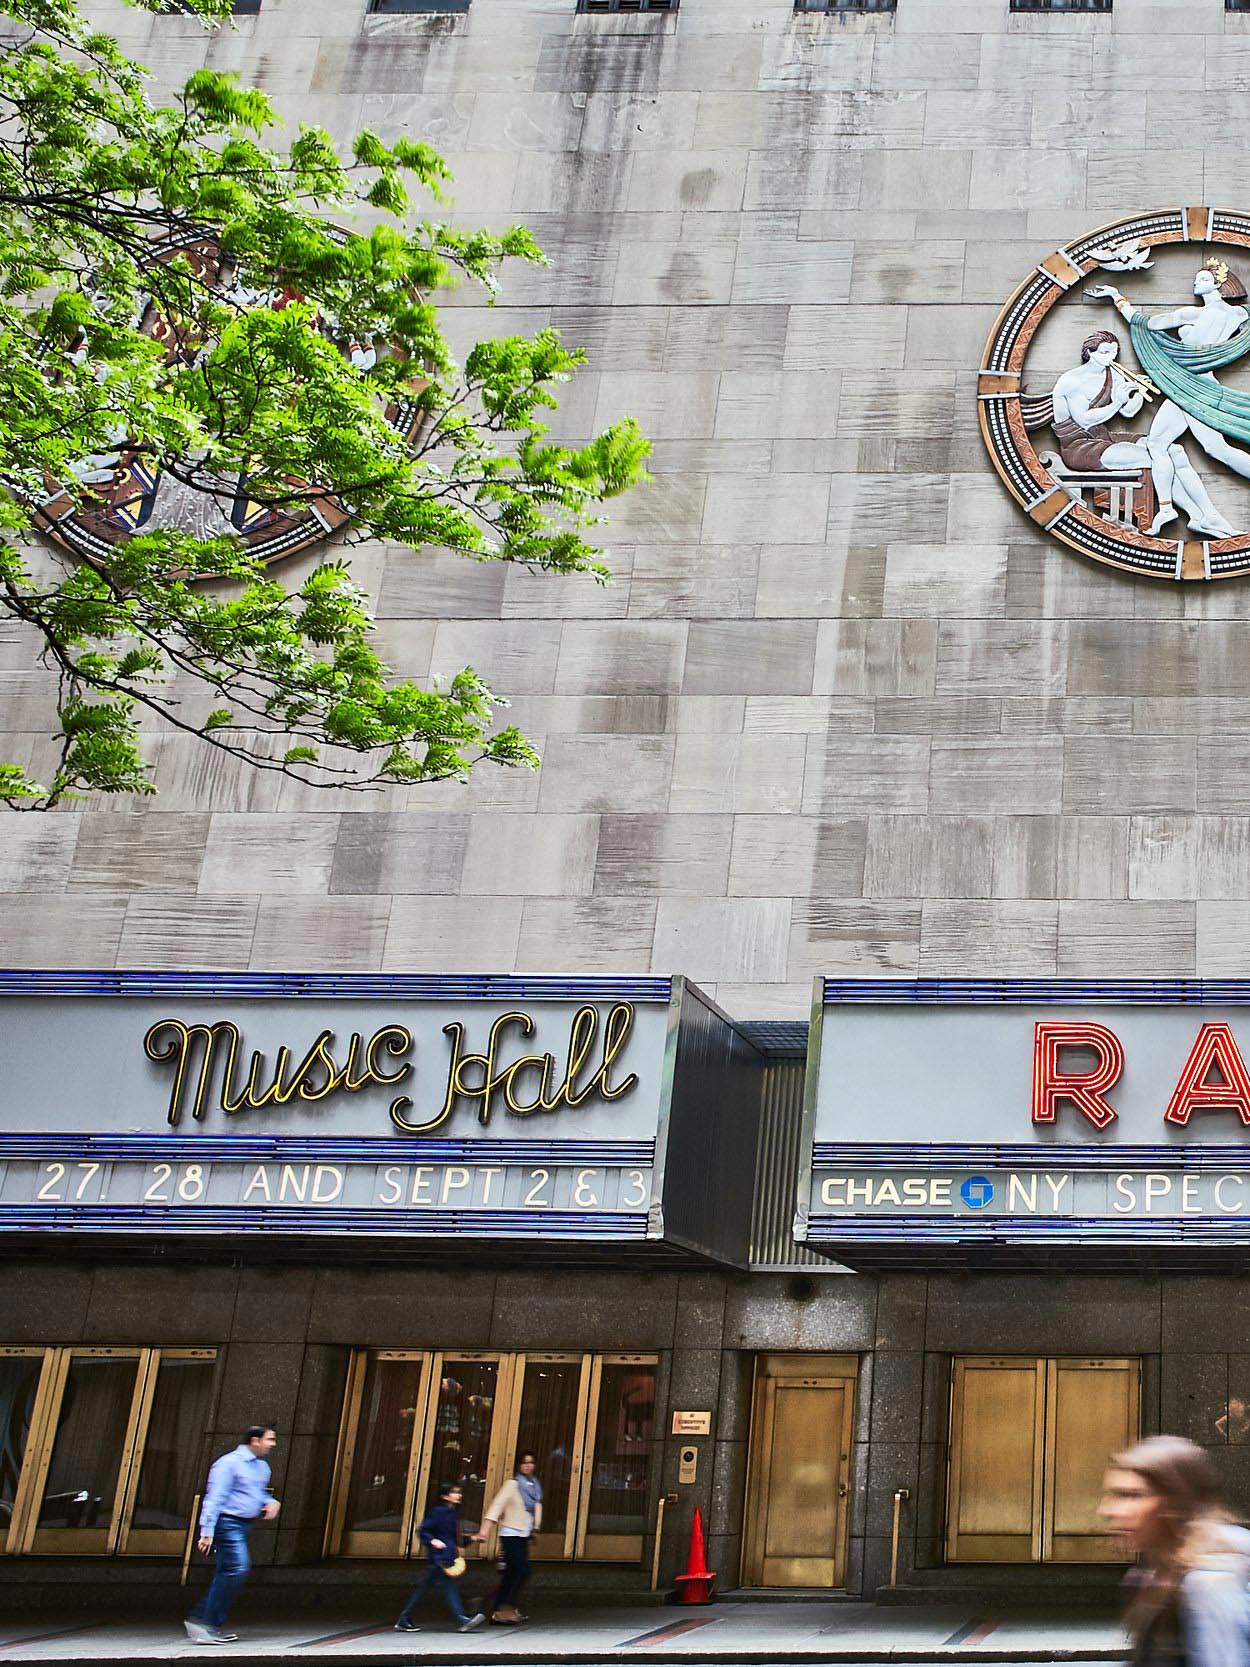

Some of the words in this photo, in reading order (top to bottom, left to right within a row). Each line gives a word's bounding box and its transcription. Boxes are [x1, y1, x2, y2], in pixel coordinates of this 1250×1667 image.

[143, 1018, 415, 1127] Music
[389, 1000, 639, 1133] Hall
[144, 1163, 204, 1201] 28
[243, 1165, 343, 1203] AND
[379, 1167, 501, 1204] SEPT
[524, 1169, 549, 1206] 2
[573, 1169, 598, 1207] &
[623, 1170, 647, 1207] 3
[821, 1178, 953, 1206] CHASE
[1009, 1174, 1069, 1212] NY
